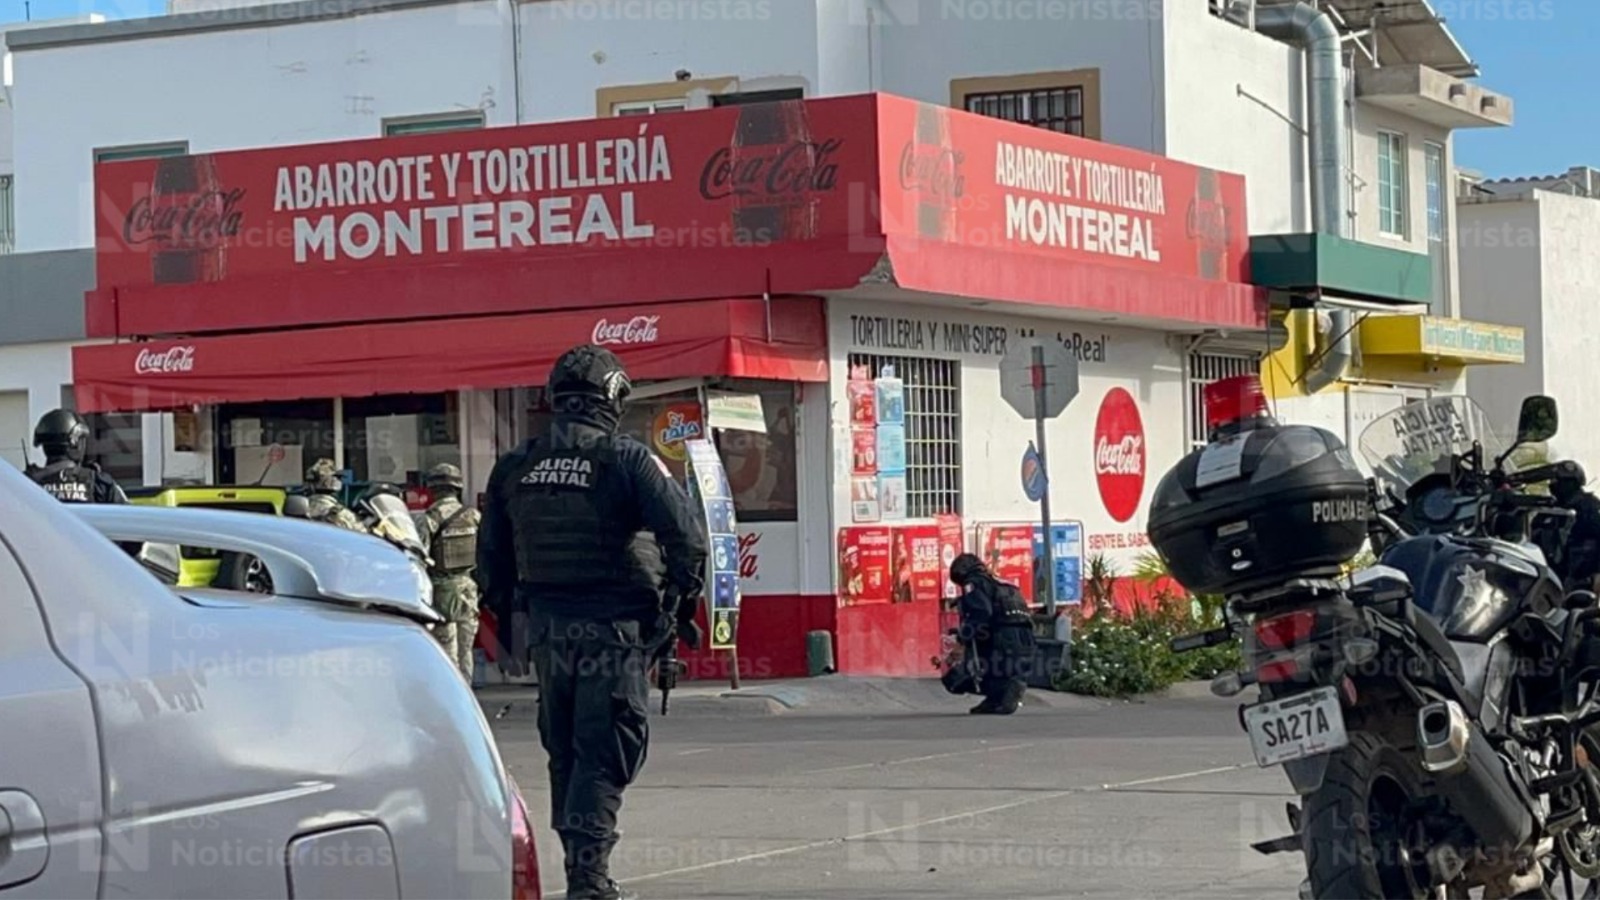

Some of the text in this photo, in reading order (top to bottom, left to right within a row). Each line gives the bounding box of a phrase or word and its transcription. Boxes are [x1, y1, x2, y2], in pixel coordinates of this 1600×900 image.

[274, 123, 671, 212] ABARROTE Y TORTILLERÍA
[996, 140, 1165, 215] ABARROTE Y TORTILLERÍA
[293, 191, 654, 262] MONTEREAL
[1005, 194, 1160, 262] MONTEREAL
[851, 315, 922, 350] TORTILLERIA
[928, 322, 938, 351] Y
[1262, 706, 1330, 747] SA27A
